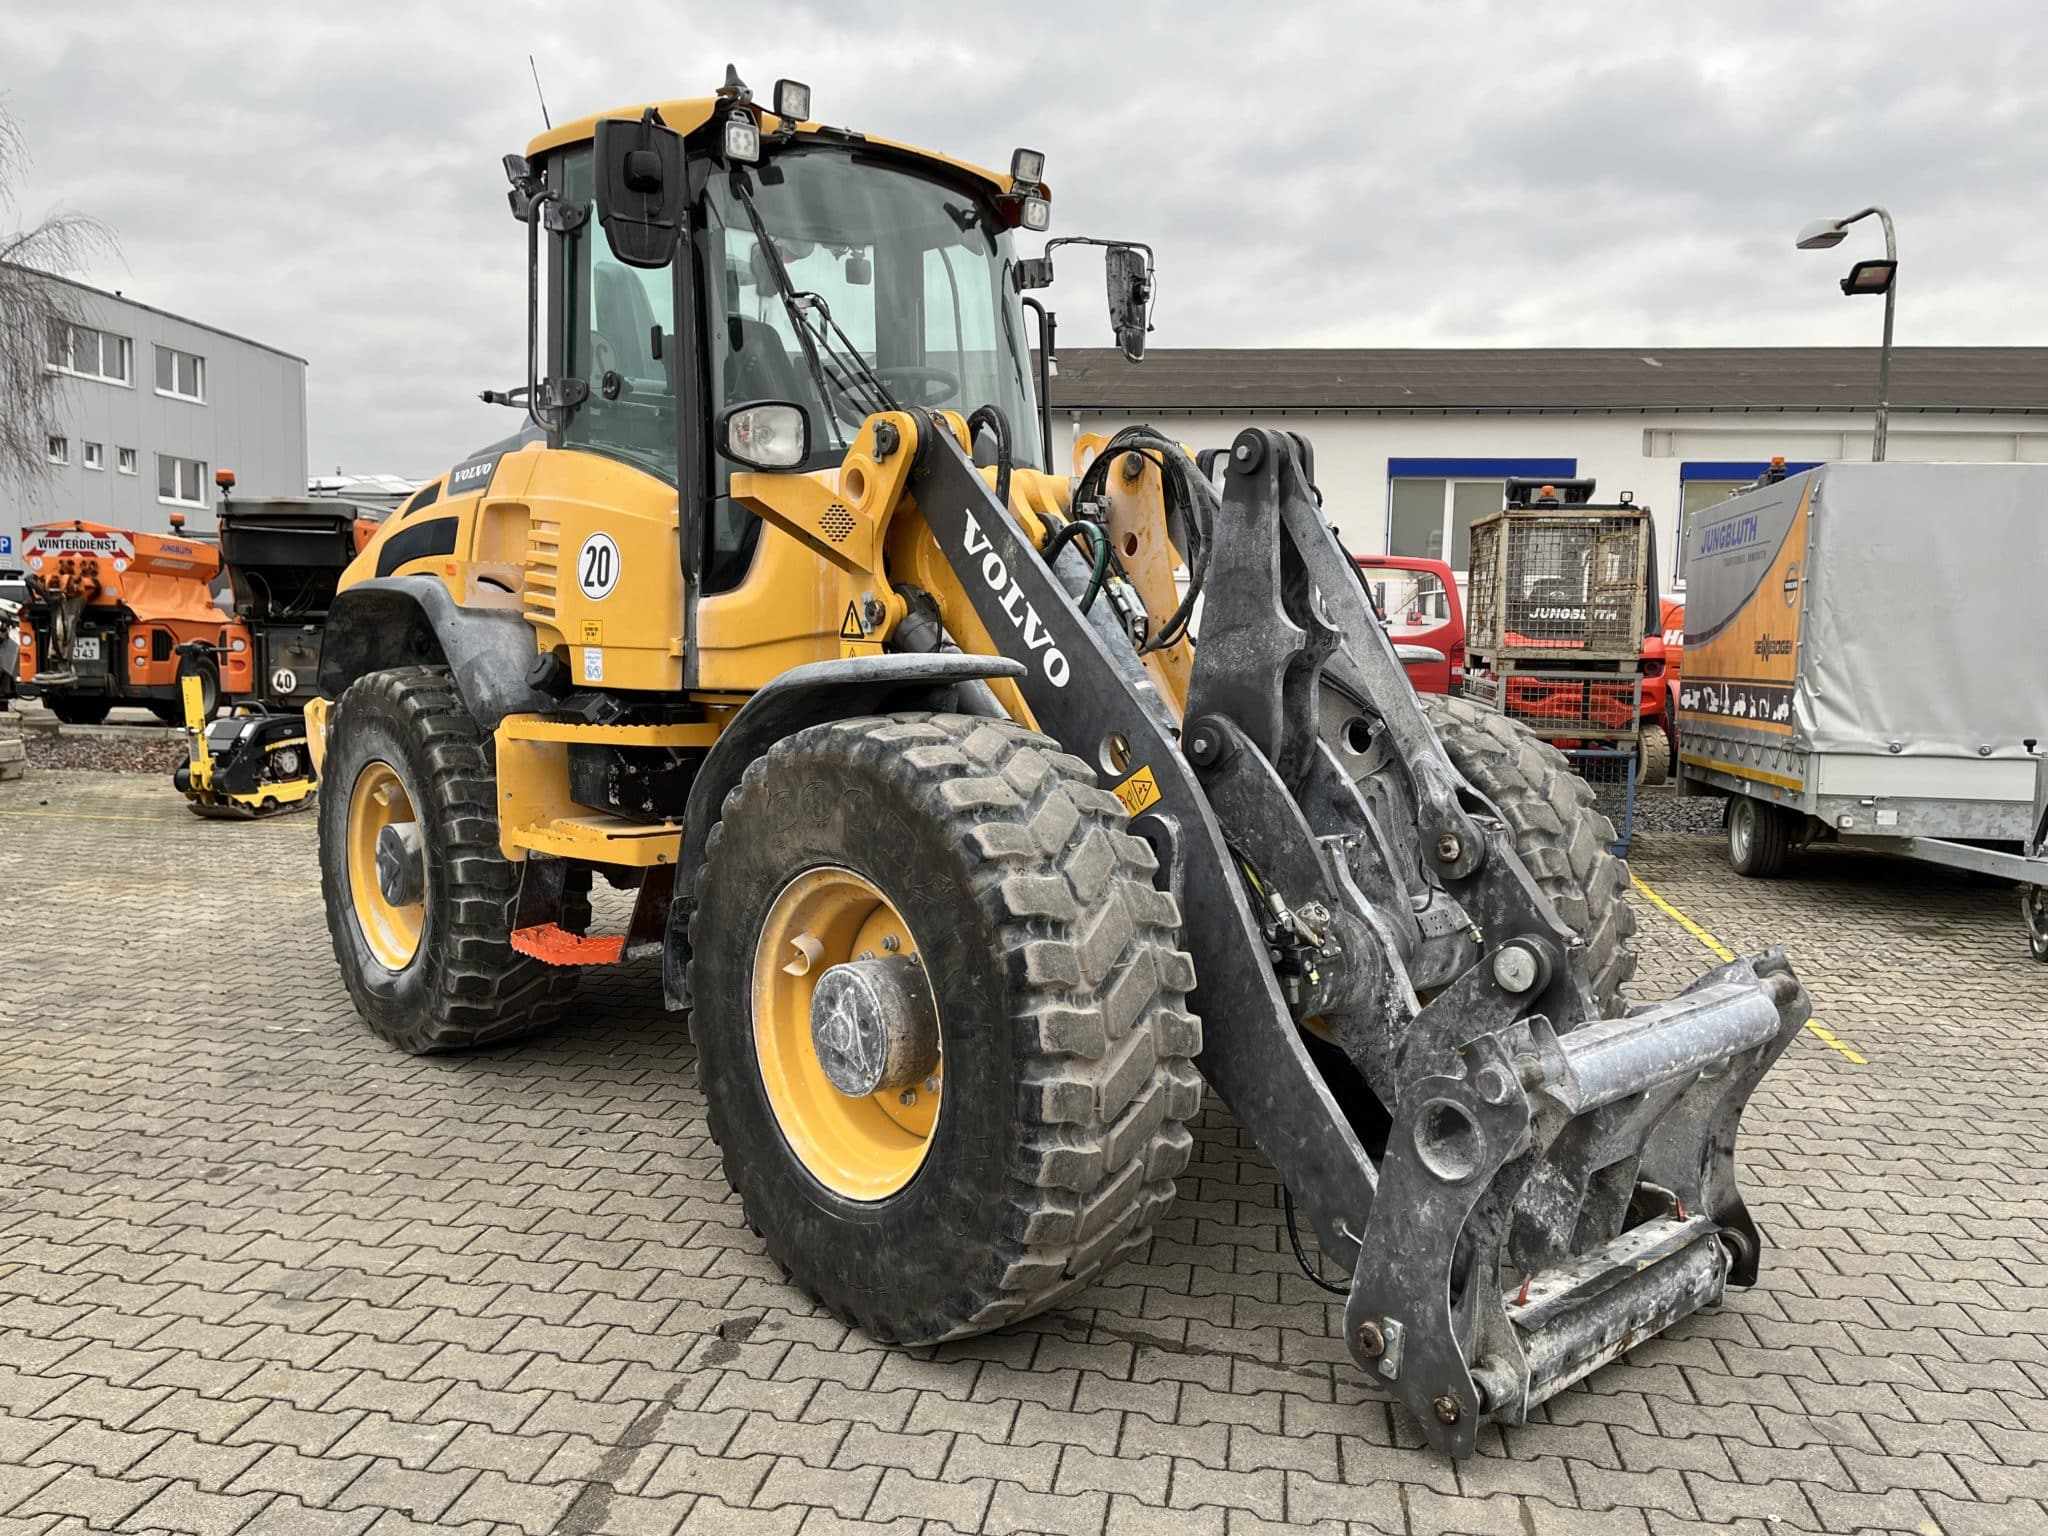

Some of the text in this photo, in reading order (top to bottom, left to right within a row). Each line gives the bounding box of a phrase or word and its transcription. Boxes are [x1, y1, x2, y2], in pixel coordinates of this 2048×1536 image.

[455, 462, 492, 483] VOLVO
[1701, 515, 1758, 554] JUNGBLUTH
[1, 538, 9, 552] P
[38, 538, 118, 551] WINTERDIENST
[583, 545, 611, 588] 20
[963, 507, 1070, 688] VOLVO
[1529, 607, 1617, 621] JUNGBLTH
[276, 673, 292, 689] 40
